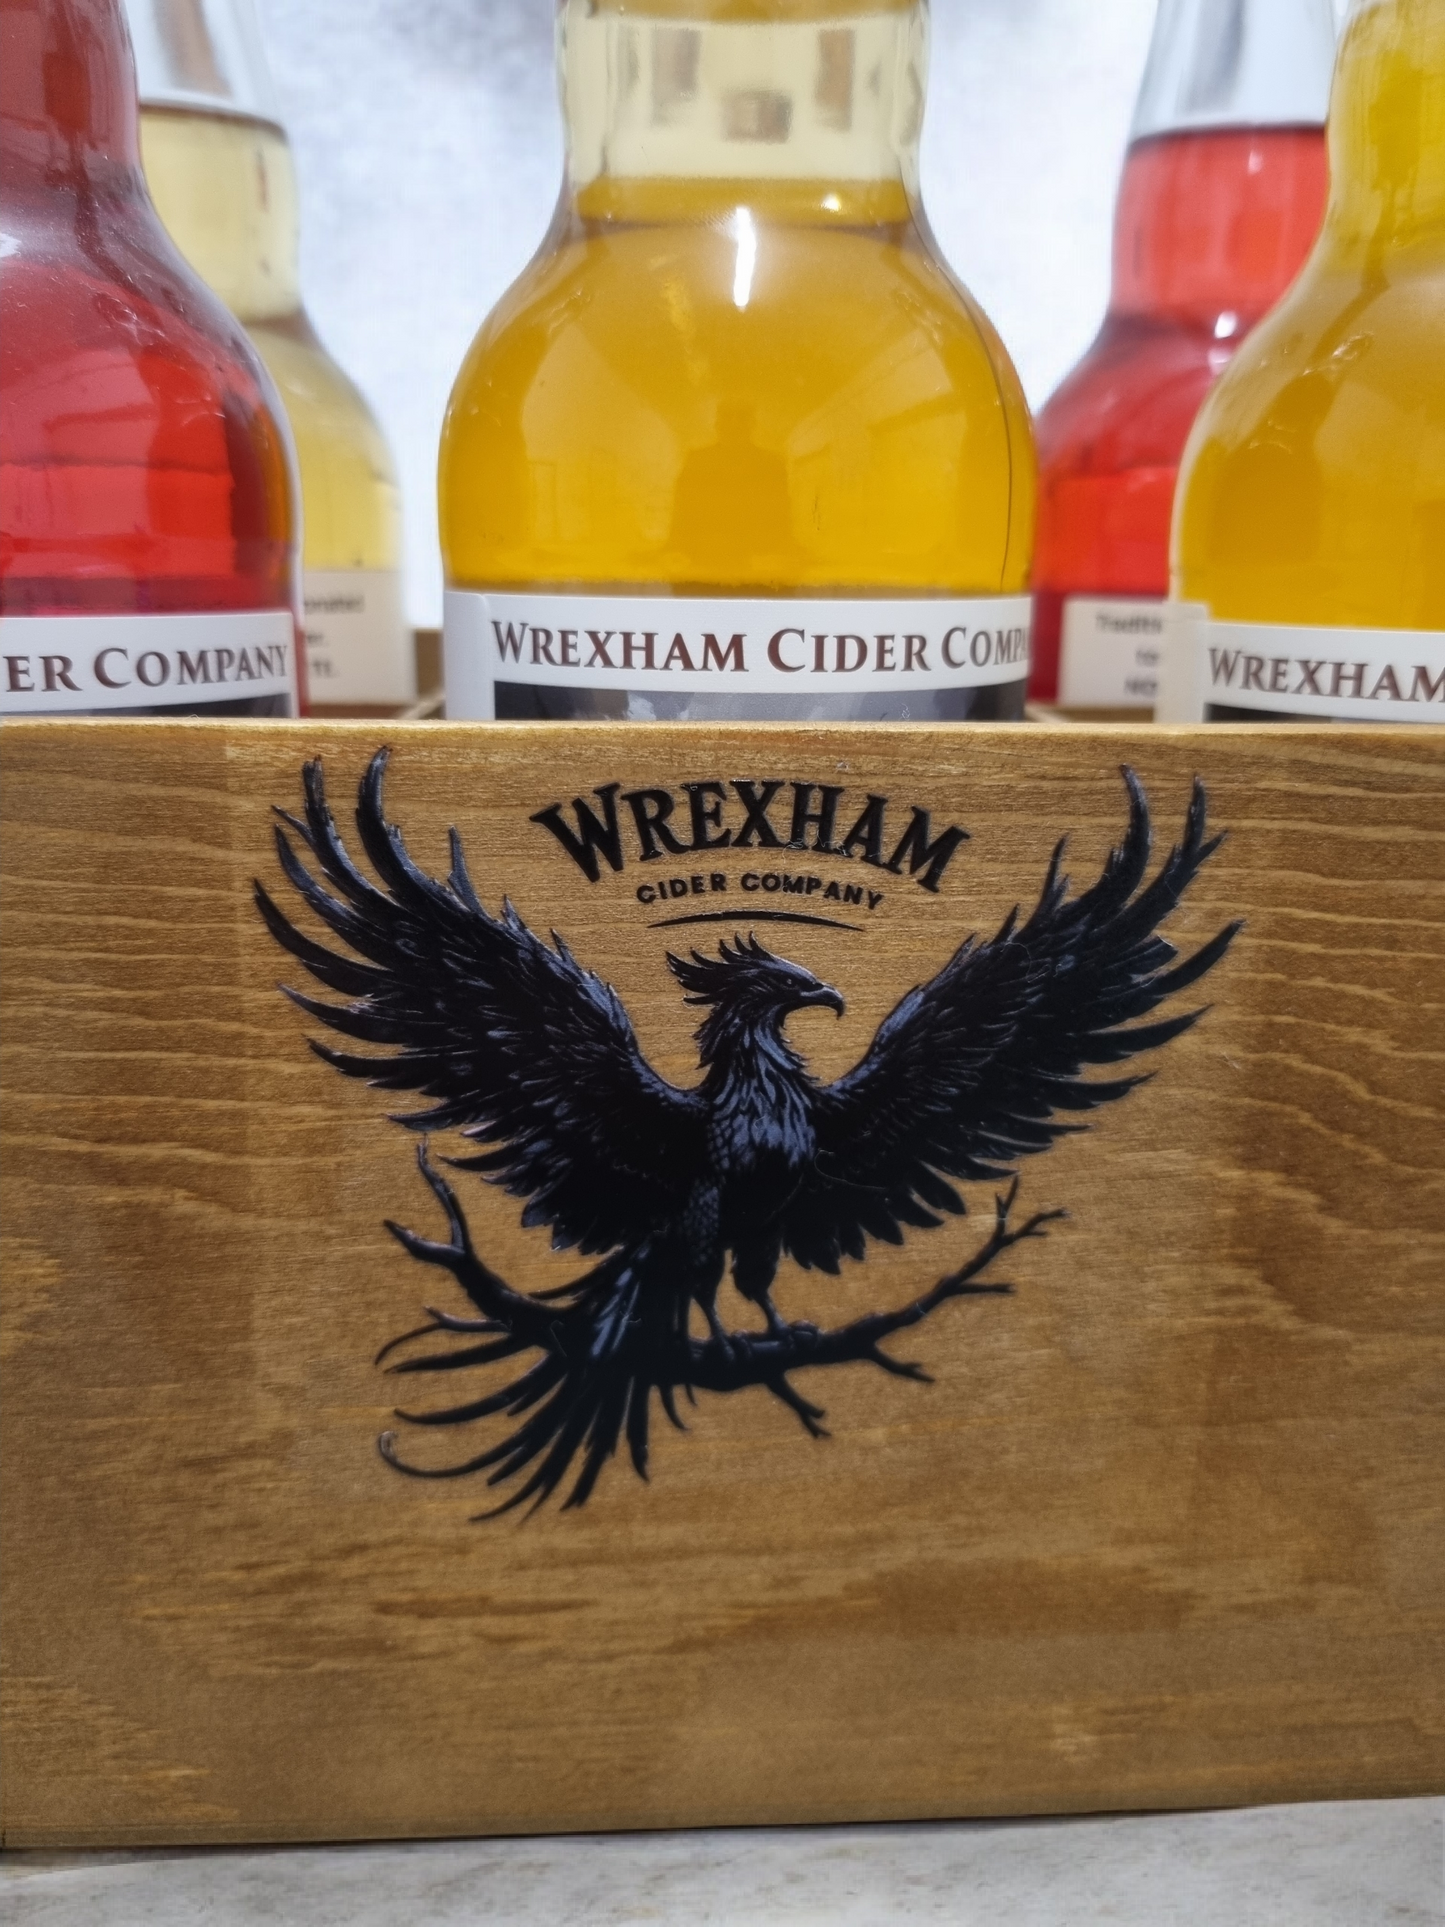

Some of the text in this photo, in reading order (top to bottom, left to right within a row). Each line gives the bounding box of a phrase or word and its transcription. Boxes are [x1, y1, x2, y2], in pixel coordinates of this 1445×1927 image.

[93, 645, 288, 690] COMPANY
[492, 620, 749, 673] WREXHAM
[767, 627, 932, 673] CIDER
[1209, 647, 1445, 704] WREXHAM
[529, 779, 971, 894] WREXHAM
[636, 872, 885, 911] CIDER COMPANY
